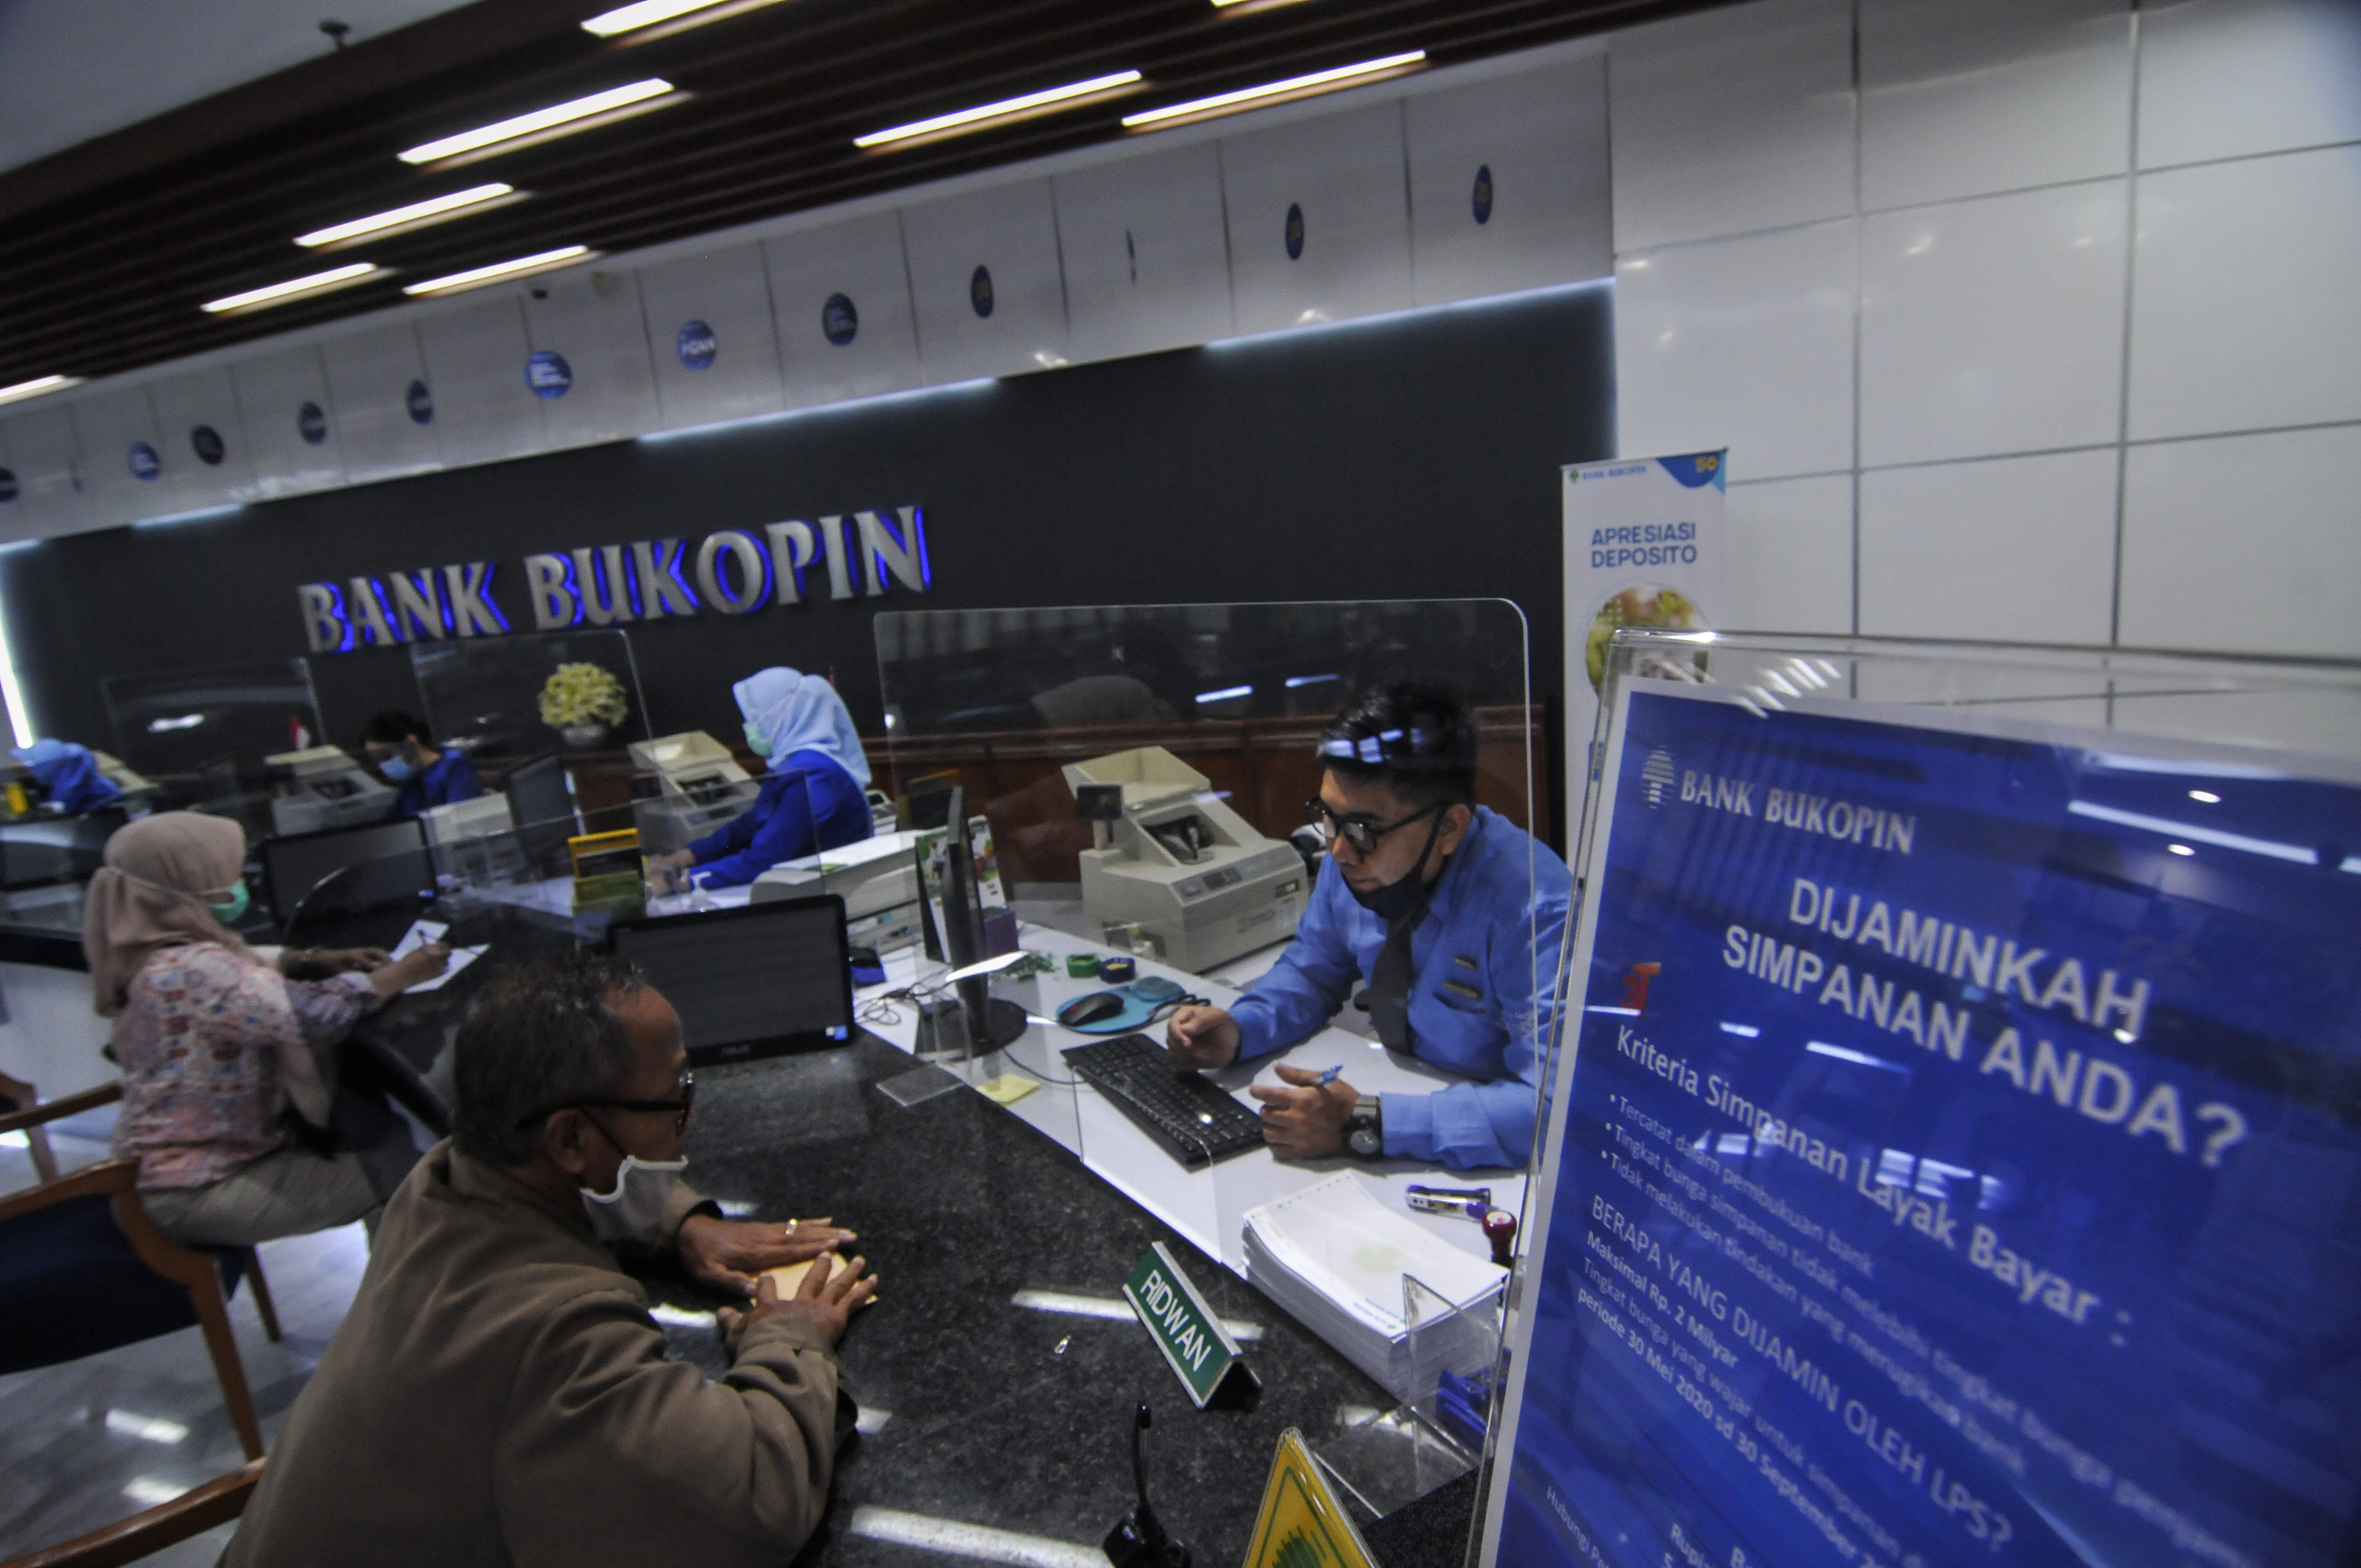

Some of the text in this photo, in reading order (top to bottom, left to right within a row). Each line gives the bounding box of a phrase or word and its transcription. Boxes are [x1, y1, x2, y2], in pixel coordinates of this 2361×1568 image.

[299, 506, 931, 653] BANK BUKOPIN
[1591, 522, 1696, 546] APRESIASI
[1591, 545, 1698, 568] DEPOSITO
[1680, 770, 1917, 855] BANK BUKOPIN
[1788, 877, 2152, 1037] DIJAMINKAH
[1722, 925, 2249, 1167] SIMPANAN ANDA?
[1610, 1151, 1643, 1190] Tidak
[1645, 1181, 1722, 1249] melakukan
[1725, 1236, 1798, 1302] tindakan
[1800, 1294, 1846, 1345] yang
[1615, 1122, 1660, 1171] Tingkat
[1663, 1157, 1708, 1202] bunga
[1710, 1193, 1788, 1258] simpanan
[1791, 1248, 1839, 1292] tidak
[1618, 1024, 1698, 1096] Kriteria
[1705, 1075, 1848, 1181] Simpanan
[1858, 1157, 1958, 1251] Layak
[1968, 1223, 2102, 1325] Bayar
[1620, 1096, 1875, 1278] Tercatat dalam pembukuan bank
[1140, 1269, 1212, 1372] RIDWAN
[1584, 1256, 1627, 1308] Tingkat
[1628, 1298, 1669, 1346] bunga
[1672, 1340, 1706, 1383] yang
[1708, 1371, 1753, 1419] wajar
[1587, 1230, 1740, 1369] Maksimal Rp. 2 Milyar
[1592, 1194, 1662, 1271] BERAPA
[1667, 1253, 1728, 1321] YANG
[1732, 1305, 1840, 1413] DIJAMIN
[1843, 1399, 1926, 1484] OLEH
[1930, 1468, 2013, 1553] LPS?
[1578, 1287, 1626, 1339] periode
[1627, 1330, 1646, 1356] 30
[1646, 1347, 1675, 1384] Mei
[1676, 1374, 1714, 1419] 2020
[1736, 1431, 1758, 1462] 30
[1758, 1452, 1858, 1560] September
[1546, 1486, 1590, 1553] Hubungi
